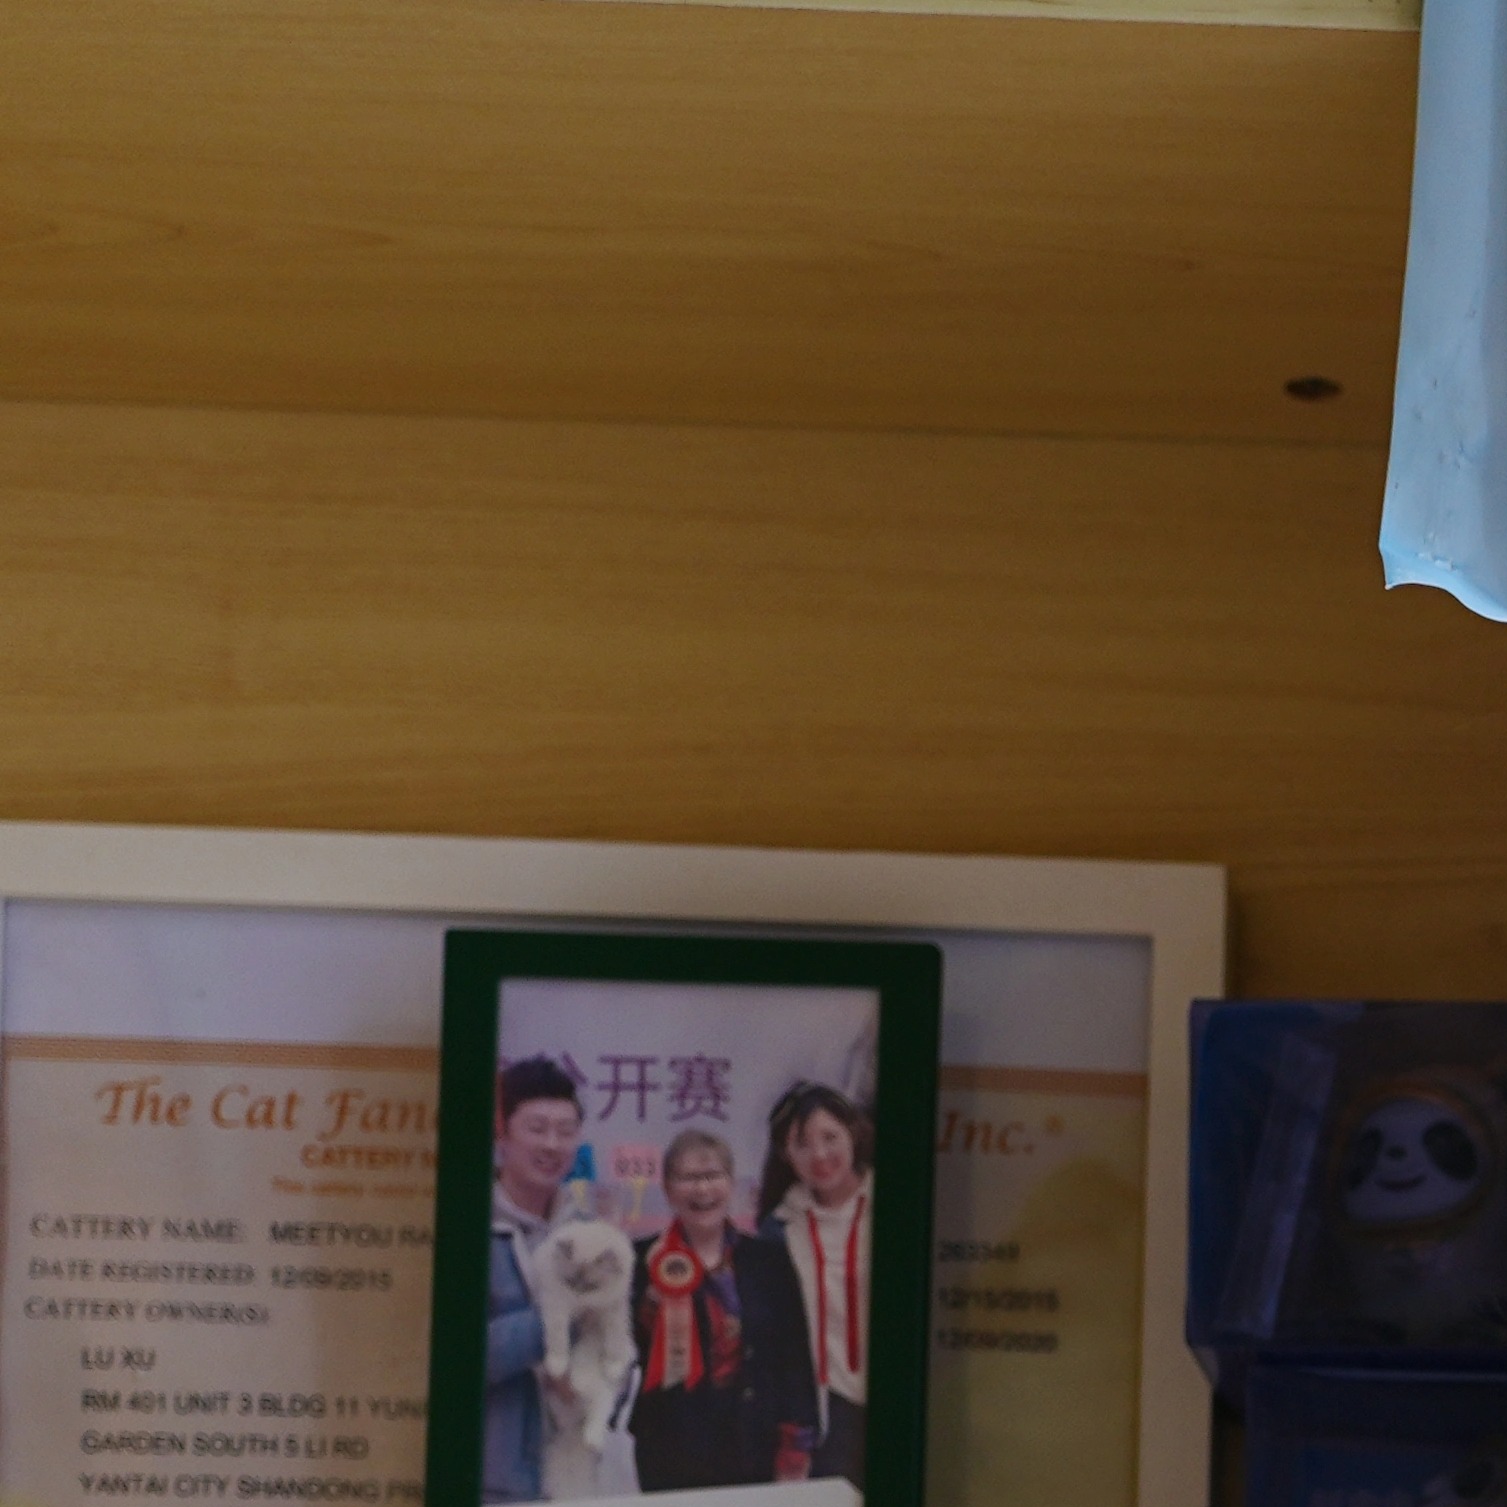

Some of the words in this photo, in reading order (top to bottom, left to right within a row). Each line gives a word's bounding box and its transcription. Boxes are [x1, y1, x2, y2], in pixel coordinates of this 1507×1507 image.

[93, 1075, 193, 1129] The
[209, 1083, 302, 1131] Cat
[80, 1346, 115, 1372] LU
[192, 1431, 279, 1457] SOUTH
